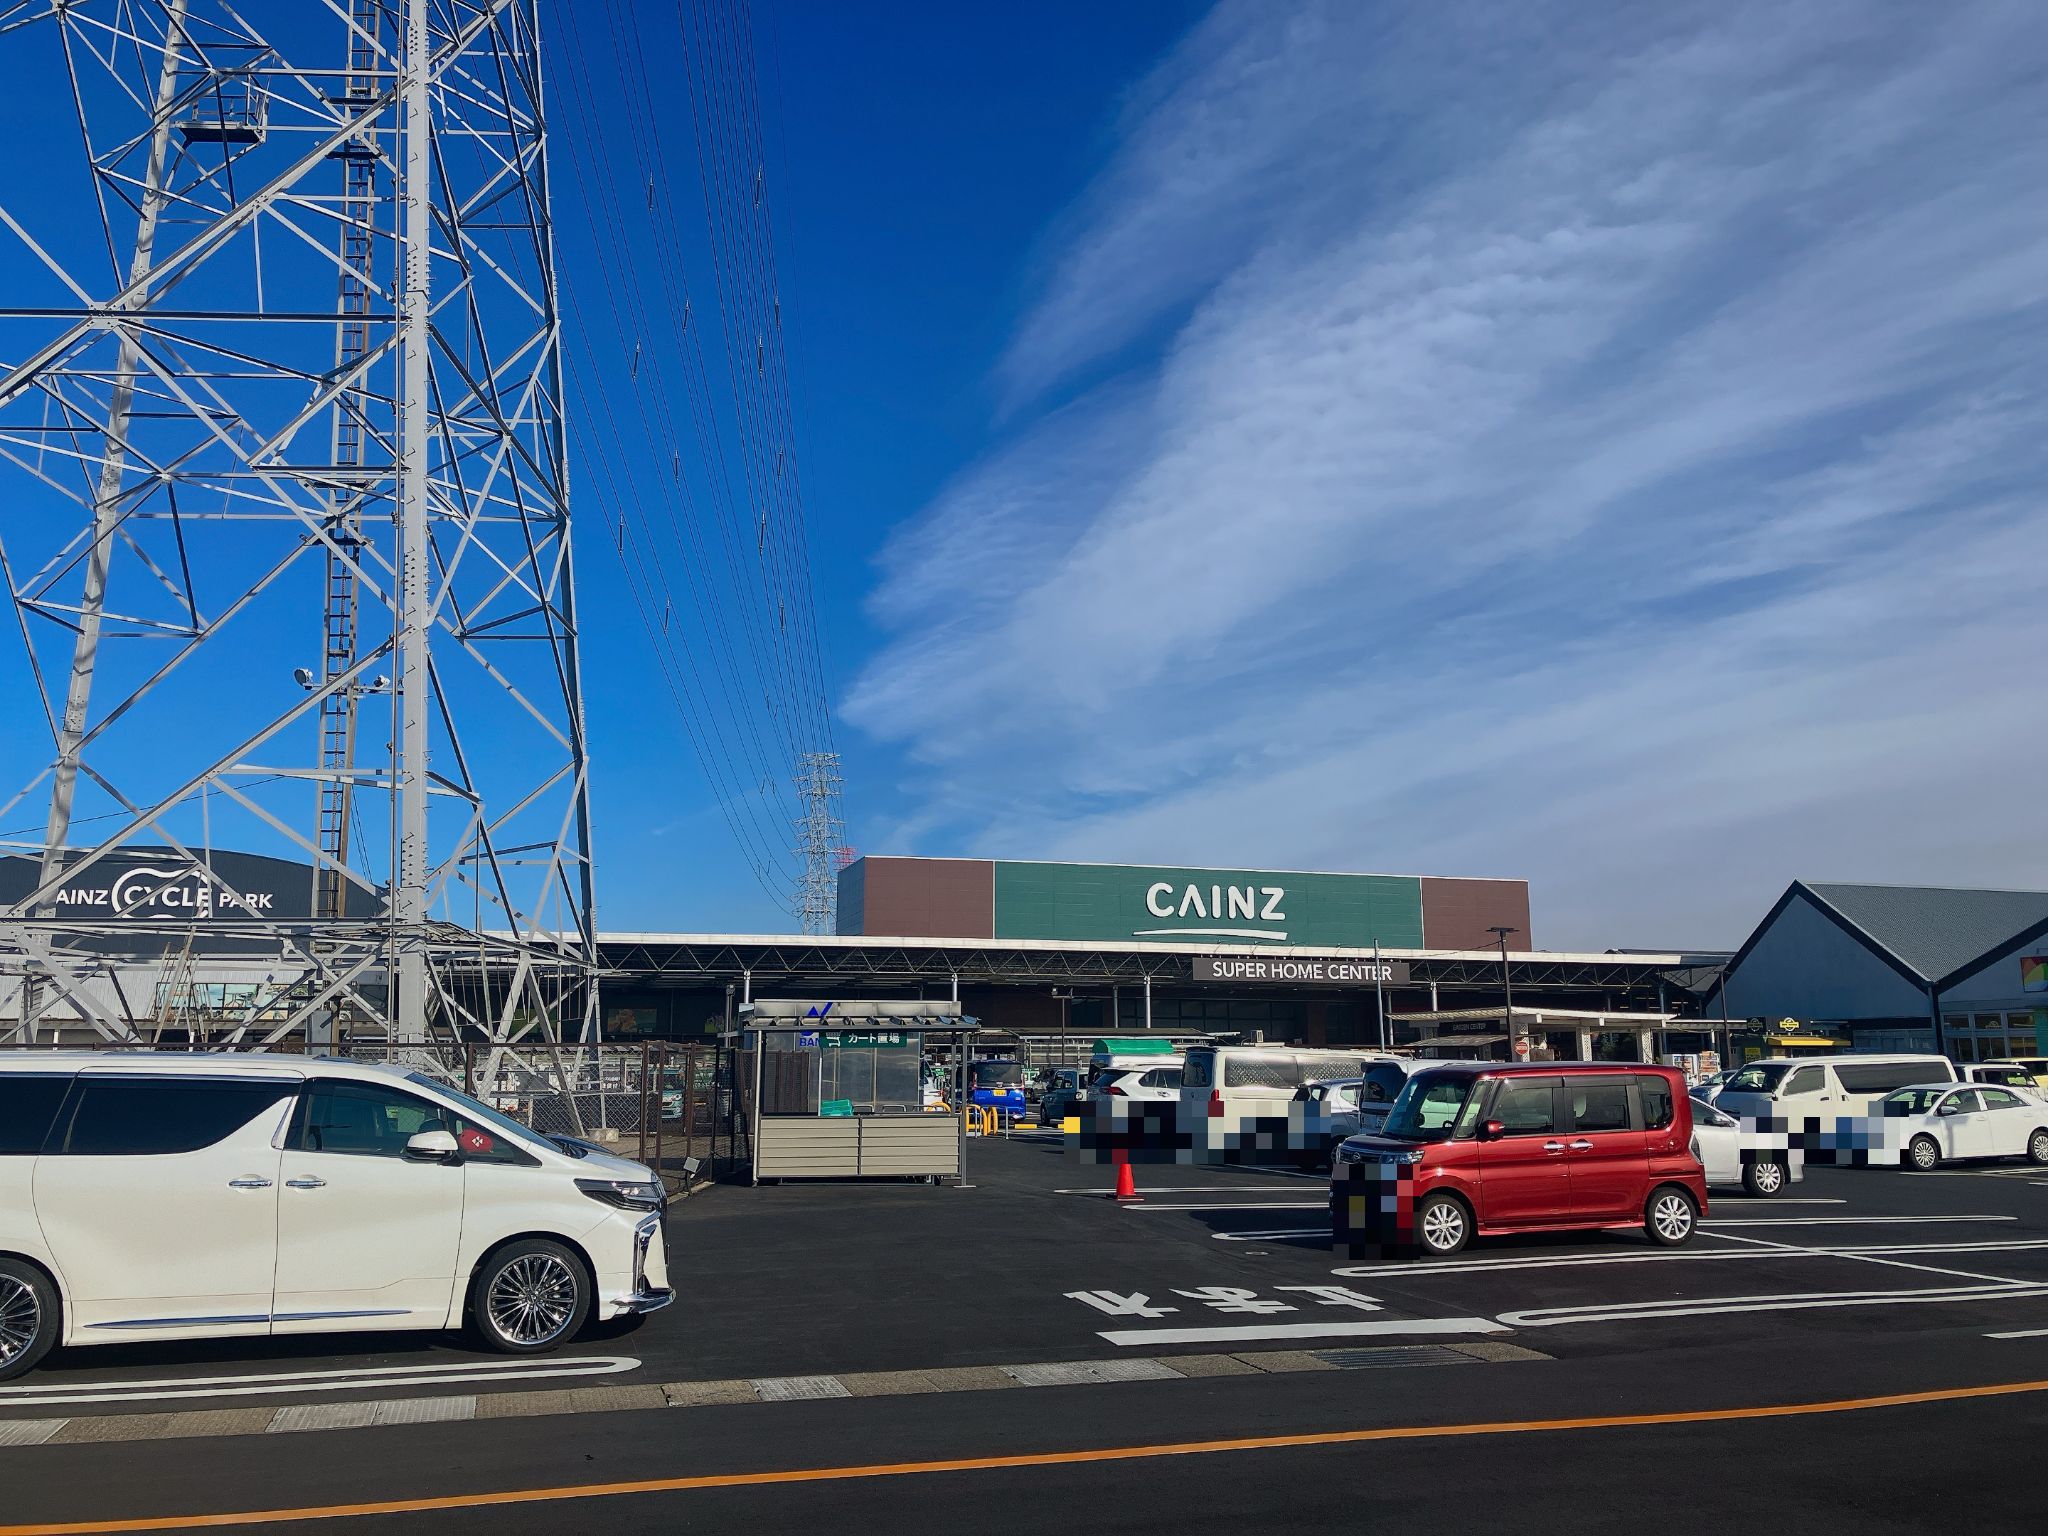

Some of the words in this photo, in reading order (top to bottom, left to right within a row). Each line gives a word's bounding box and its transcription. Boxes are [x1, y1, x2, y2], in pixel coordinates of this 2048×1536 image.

[55, 888, 109, 905] AINZ
[124, 885, 213, 908] CYCLE
[218, 892, 274, 909] PARK
[1146, 882, 1286, 921] CAINZ
[1212, 961, 1267, 978] SUPER
[1271, 963, 1324, 979] HOME
[1327, 964, 1393, 981] CENTER
[848, 1032, 900, 1044] カート置場
[1062, 1286, 1385, 1318] 止まれ
